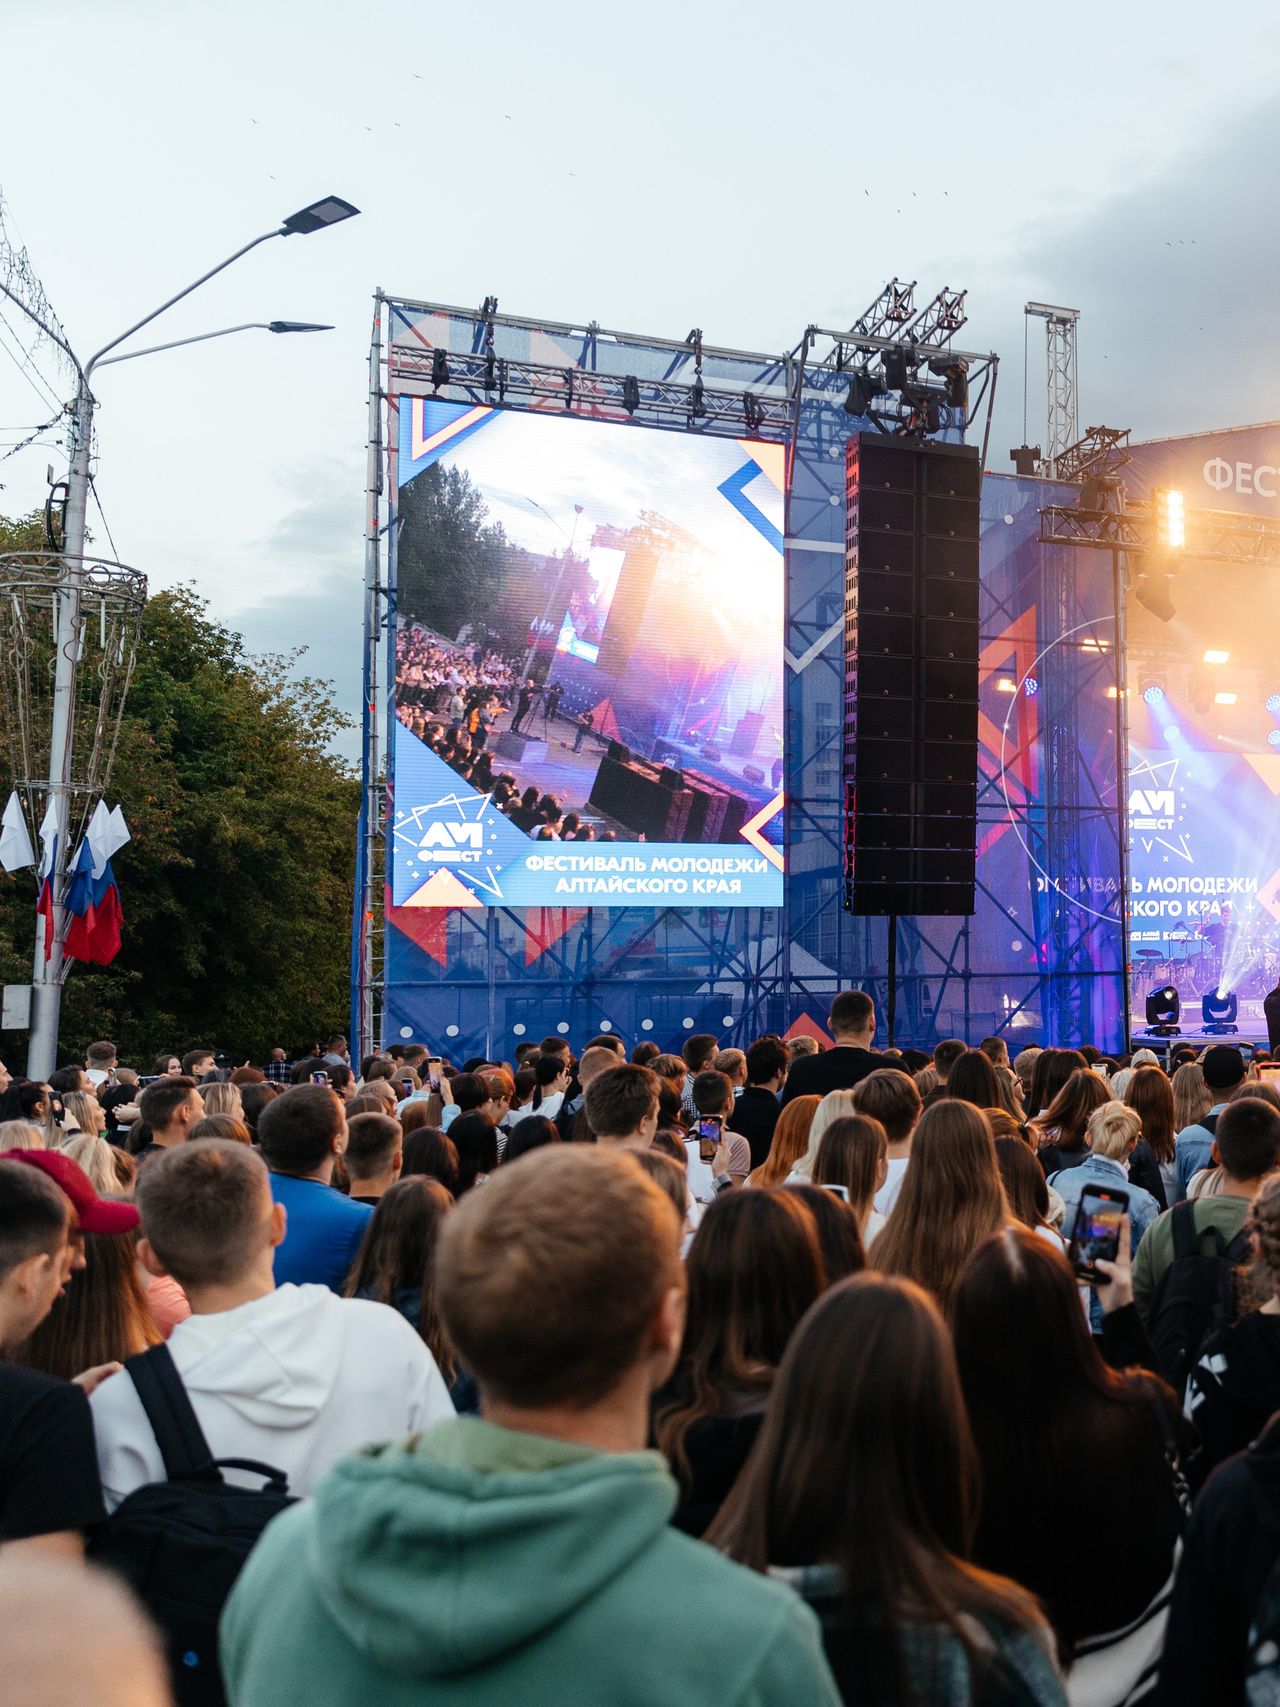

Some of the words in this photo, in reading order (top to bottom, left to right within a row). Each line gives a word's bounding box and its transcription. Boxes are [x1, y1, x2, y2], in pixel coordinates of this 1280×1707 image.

[418, 850, 482, 863] ФЕСТ
[526, 855, 646, 872] ФЕСТИВАЛЬ
[651, 859, 768, 874] МОЛОДЕЖИ
[555, 878, 688, 893] АЛТАЙСКОГО
[694, 880, 742, 894] КРАЯ
[1147, 877, 1258, 895] МОЛОДЕЖИ
